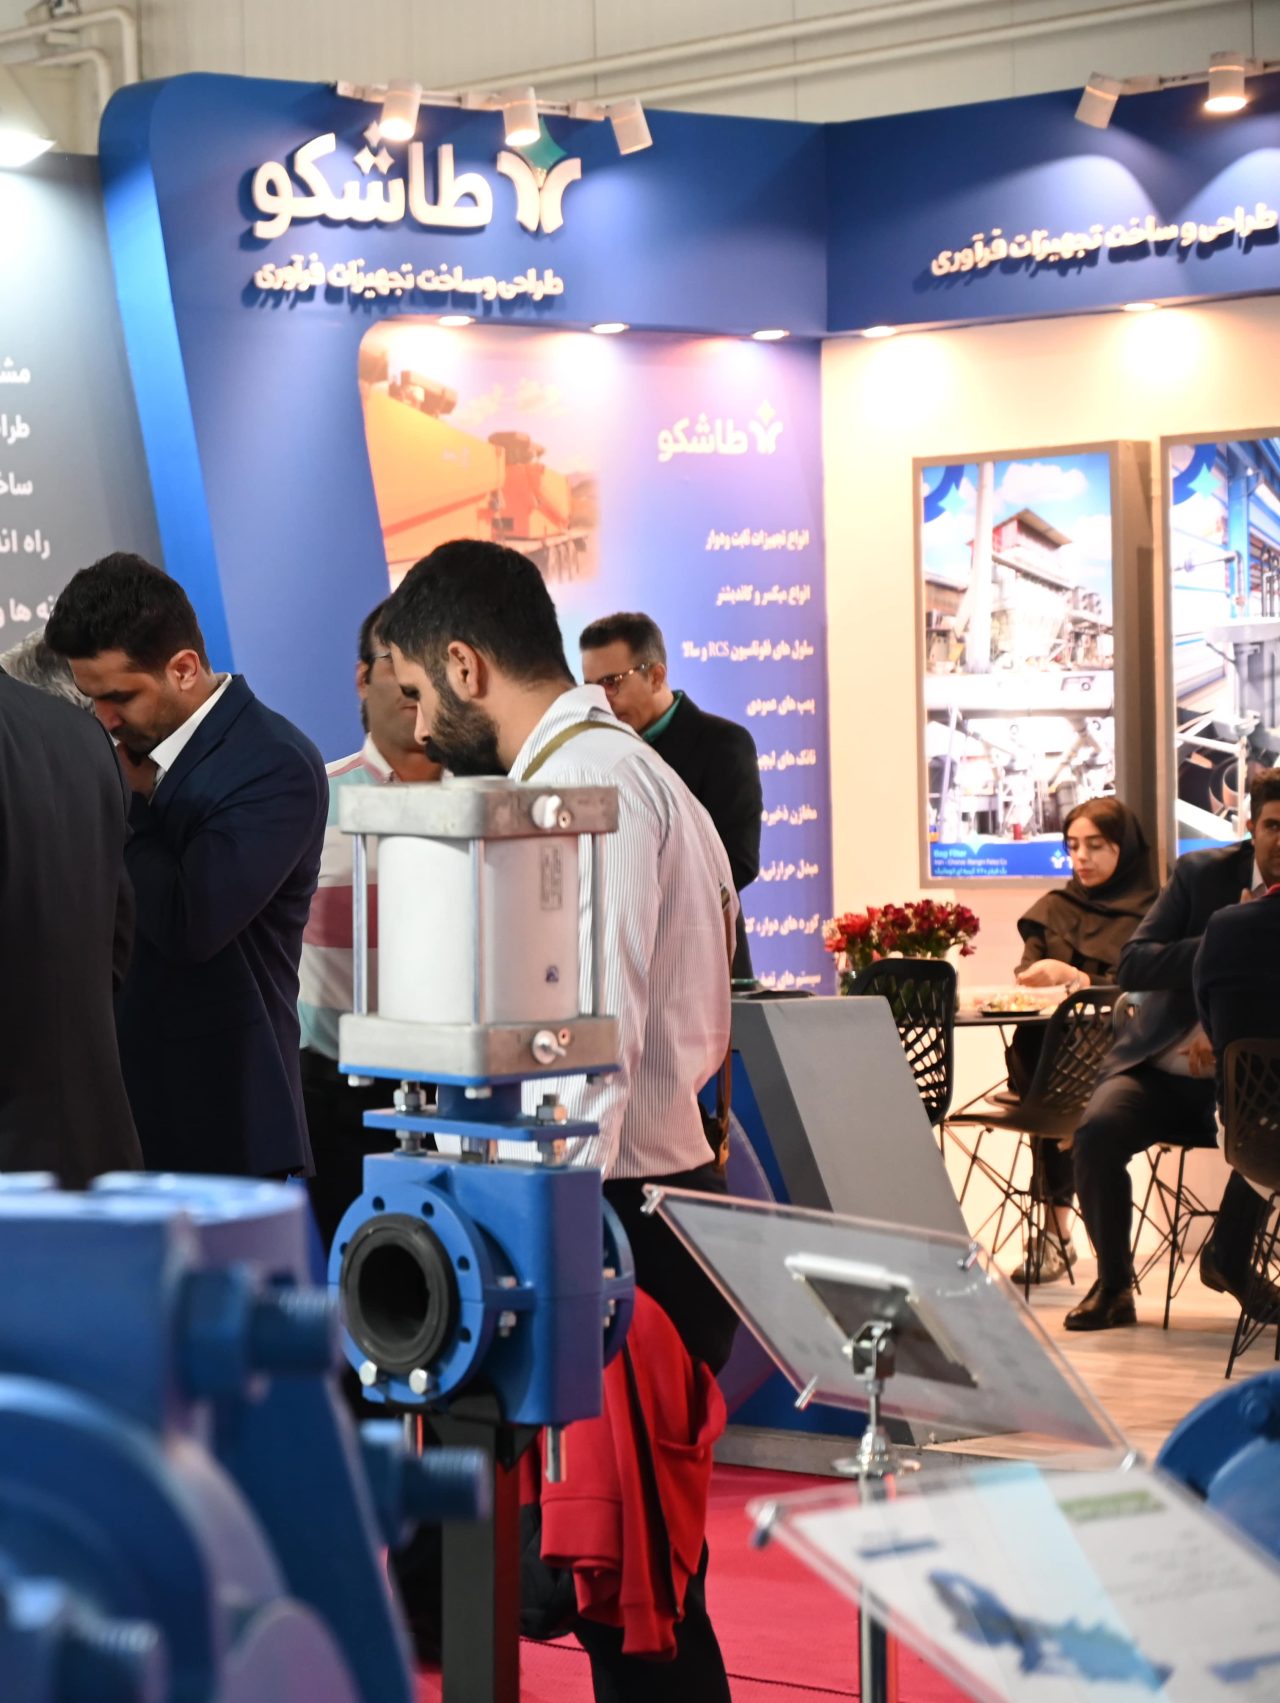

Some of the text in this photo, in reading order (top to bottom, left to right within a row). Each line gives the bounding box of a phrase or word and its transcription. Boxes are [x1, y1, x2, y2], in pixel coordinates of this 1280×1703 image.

[252, 119, 493, 240] طاشکو
[1105, 214, 1180, 249] ساخت
[1198, 201, 1280, 242] طراحی
[1010, 224, 1104, 262] تجهیزات
[327, 257, 416, 298] تجهیزات
[497, 267, 564, 300] طراحی
[657, 411, 749, 463] طاشکو
[24, 529, 51, 560] راه
[708, 640, 730, 657] RCS
[777, 695, 797, 715] های
[777, 749, 796, 770] های
[779, 915, 798, 936] های
